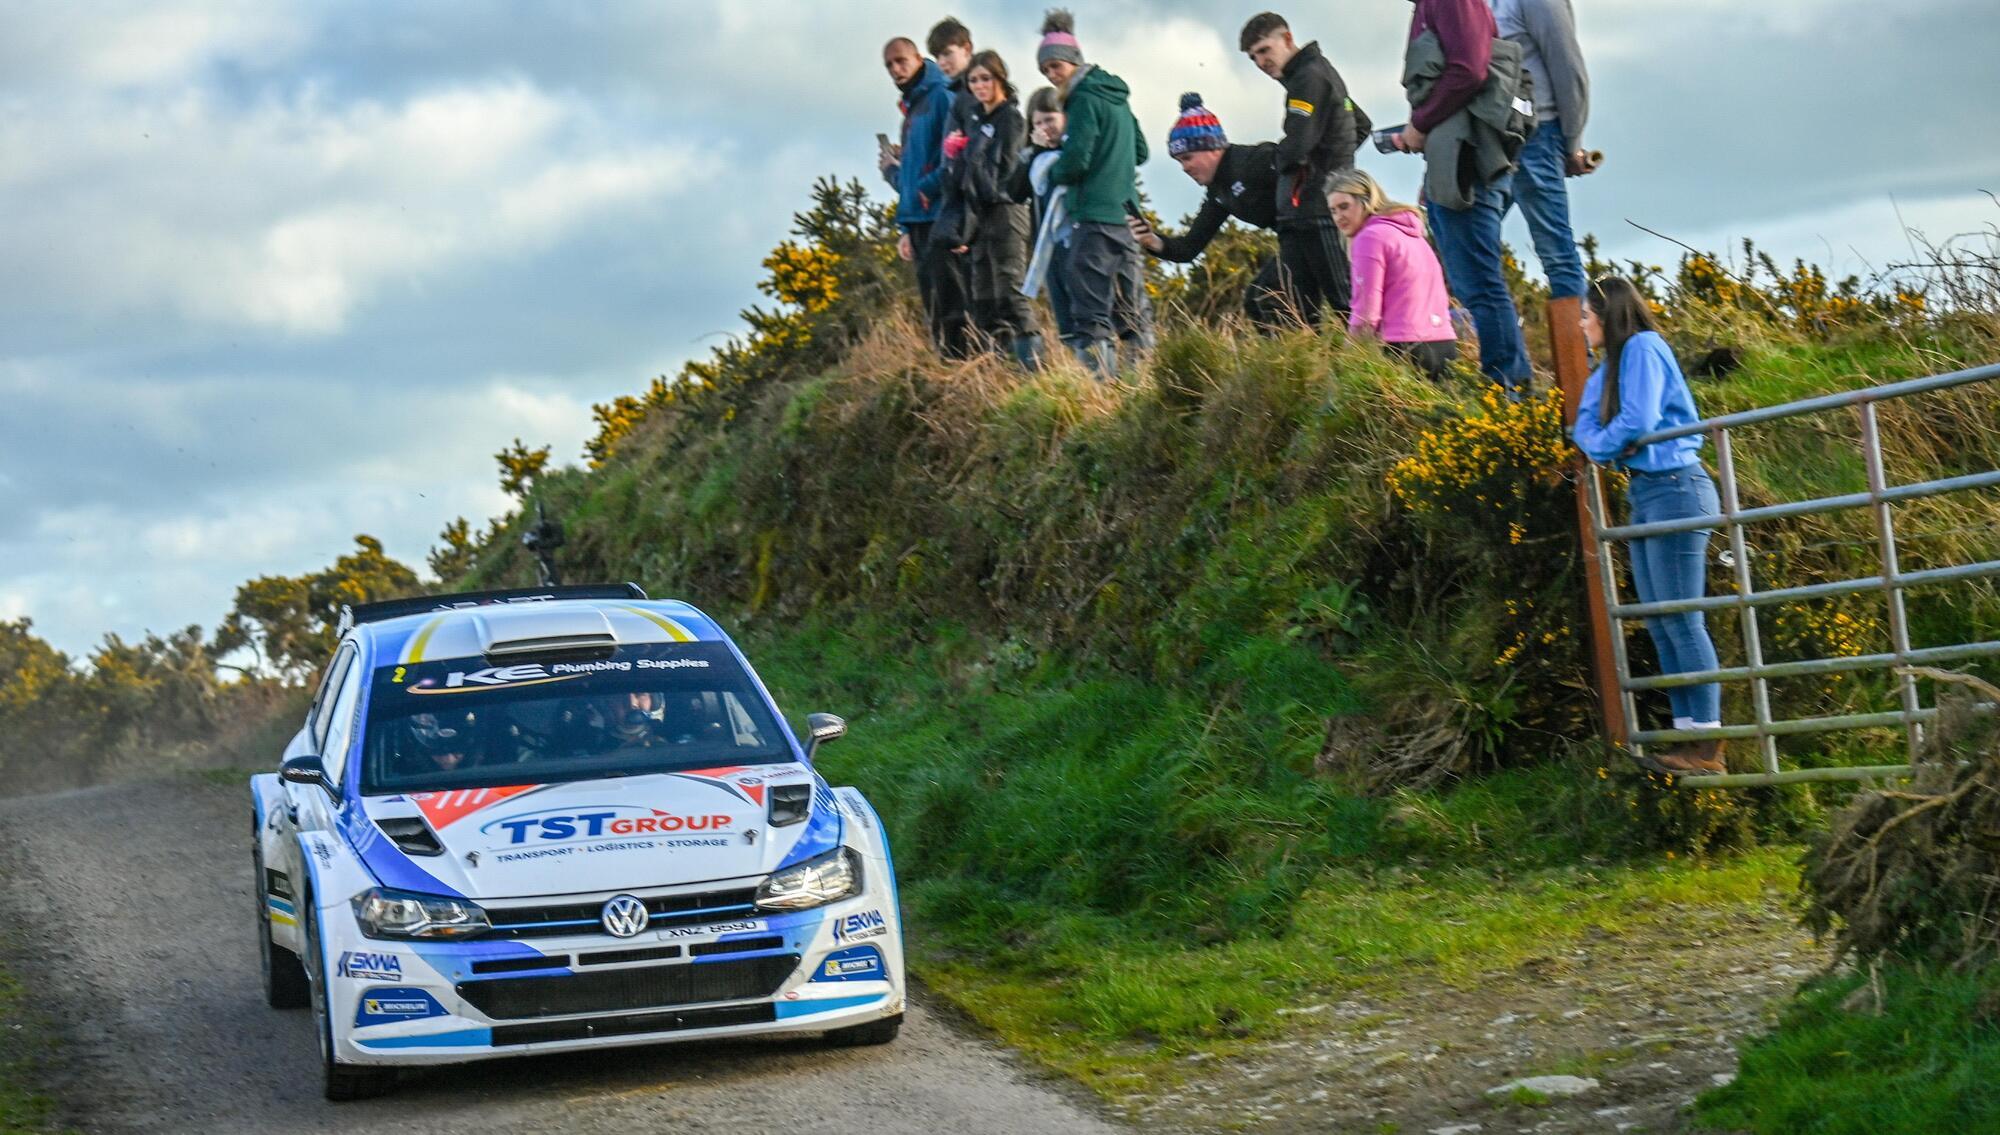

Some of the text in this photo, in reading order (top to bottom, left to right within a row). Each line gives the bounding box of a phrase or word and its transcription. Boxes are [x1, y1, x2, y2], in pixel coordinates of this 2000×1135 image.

[391, 666, 406, 684] 2
[446, 659, 709, 688] KE Plumbing Supplies
[502, 812, 732, 844] TST GROUP
[497, 837, 729, 863] TRANSPORT LOGISTICS STORAGE
[710, 920, 757, 934] 8590
[383, 1002, 426, 1011] MICHELIN
